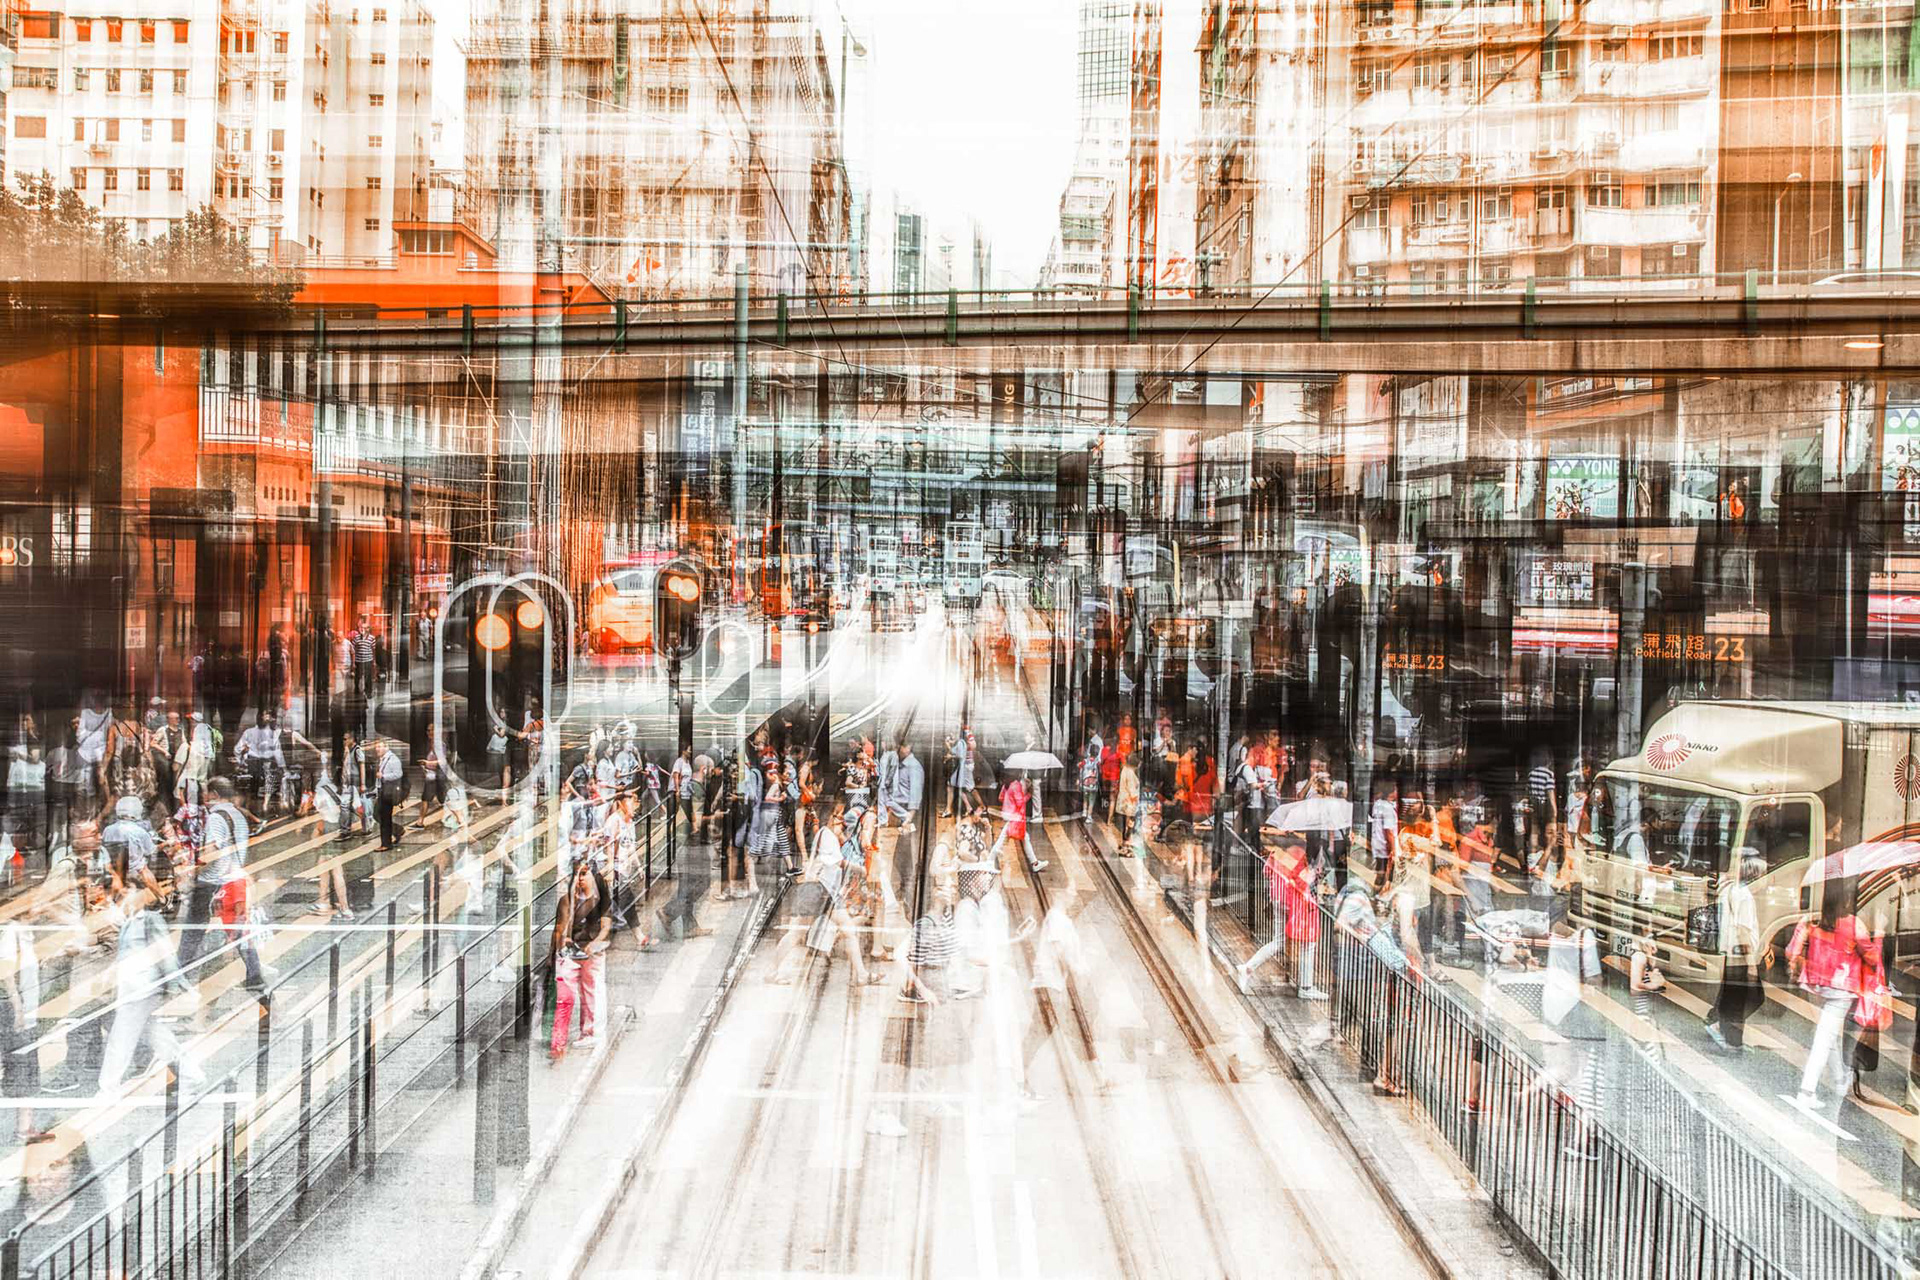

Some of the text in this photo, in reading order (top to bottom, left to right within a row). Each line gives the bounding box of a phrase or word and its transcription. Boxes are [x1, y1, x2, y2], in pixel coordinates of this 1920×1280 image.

[1643, 633, 1705, 650] 蒲飛路
[1635, 647, 1712, 660] Pokfield Road
[1714, 637, 1746, 661] 23
[1427, 655, 1445, 669] 23
[1685, 742, 1719, 752] NIKKO
